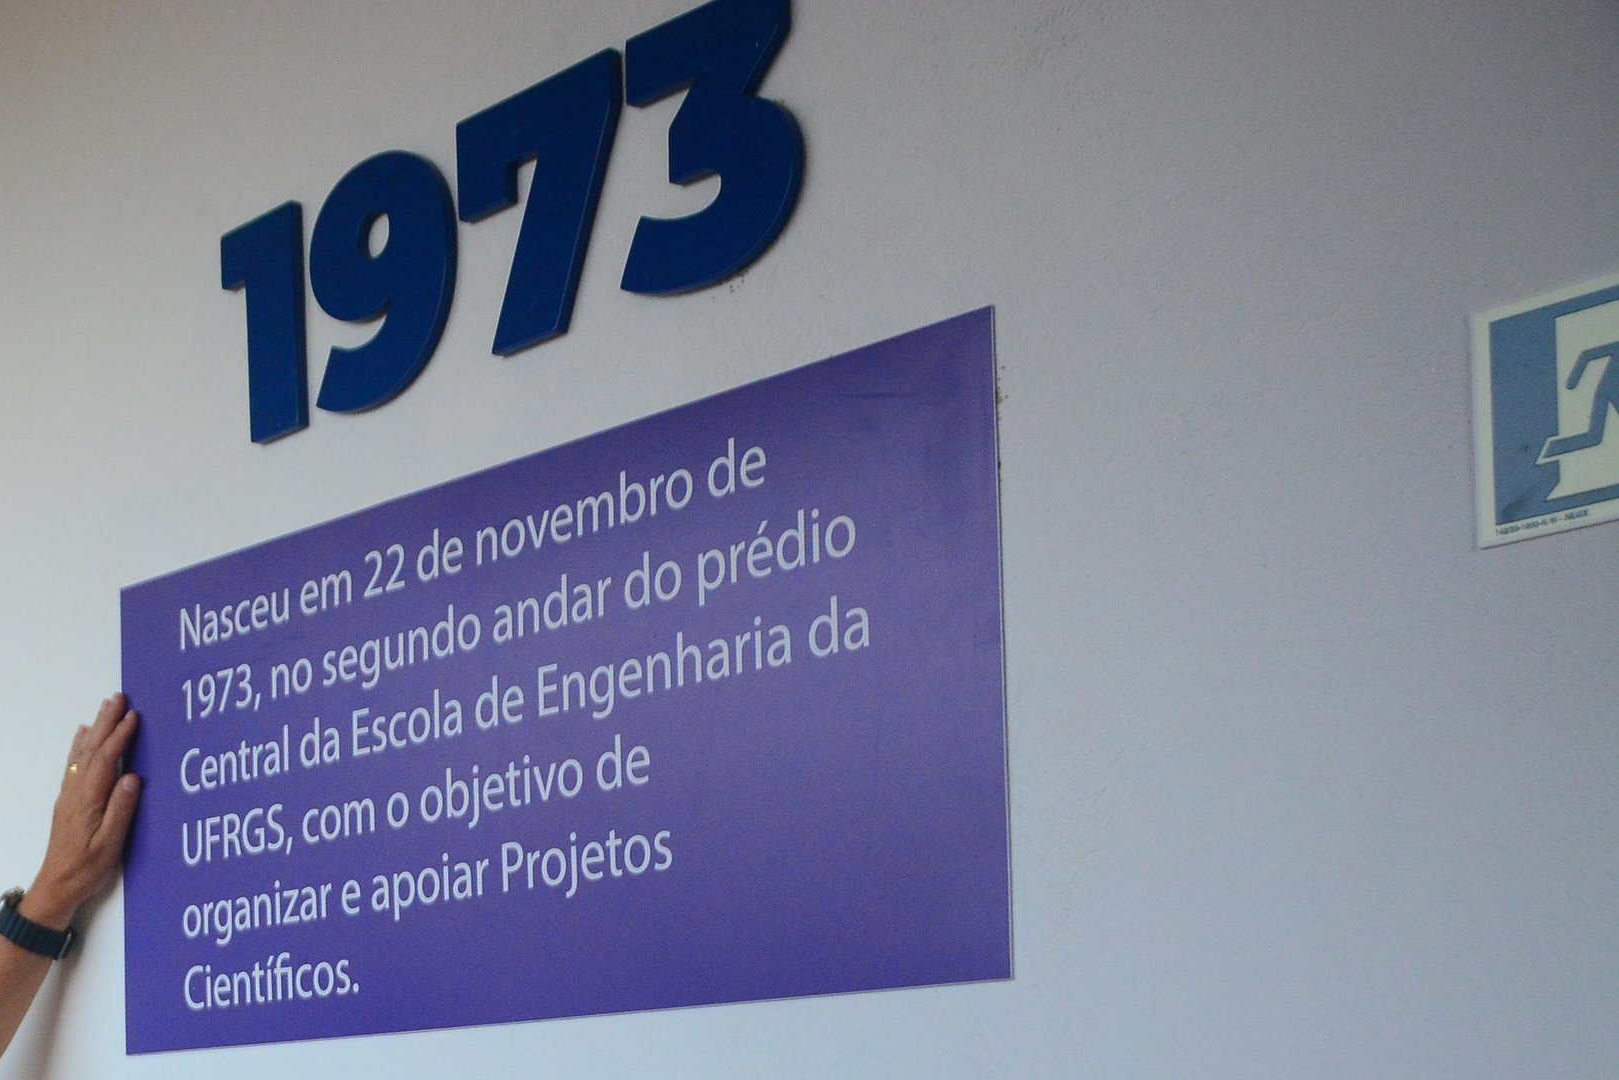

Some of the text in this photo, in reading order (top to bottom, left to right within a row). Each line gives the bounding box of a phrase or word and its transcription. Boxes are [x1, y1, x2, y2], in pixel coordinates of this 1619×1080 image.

[220, 0, 806, 445] 1973
[179, 437, 769, 649] Nasceu em 22 de novembro de
[181, 509, 857, 722] 1973, no segundo andar do prédio
[181, 599, 871, 792] Central da Escola de Engenharia da
[182, 735, 651, 867] UFRGS, com o objetivo de
[183, 826, 673, 946] organizar e apoiar Projetos
[183, 952, 360, 1011] Científicos.
